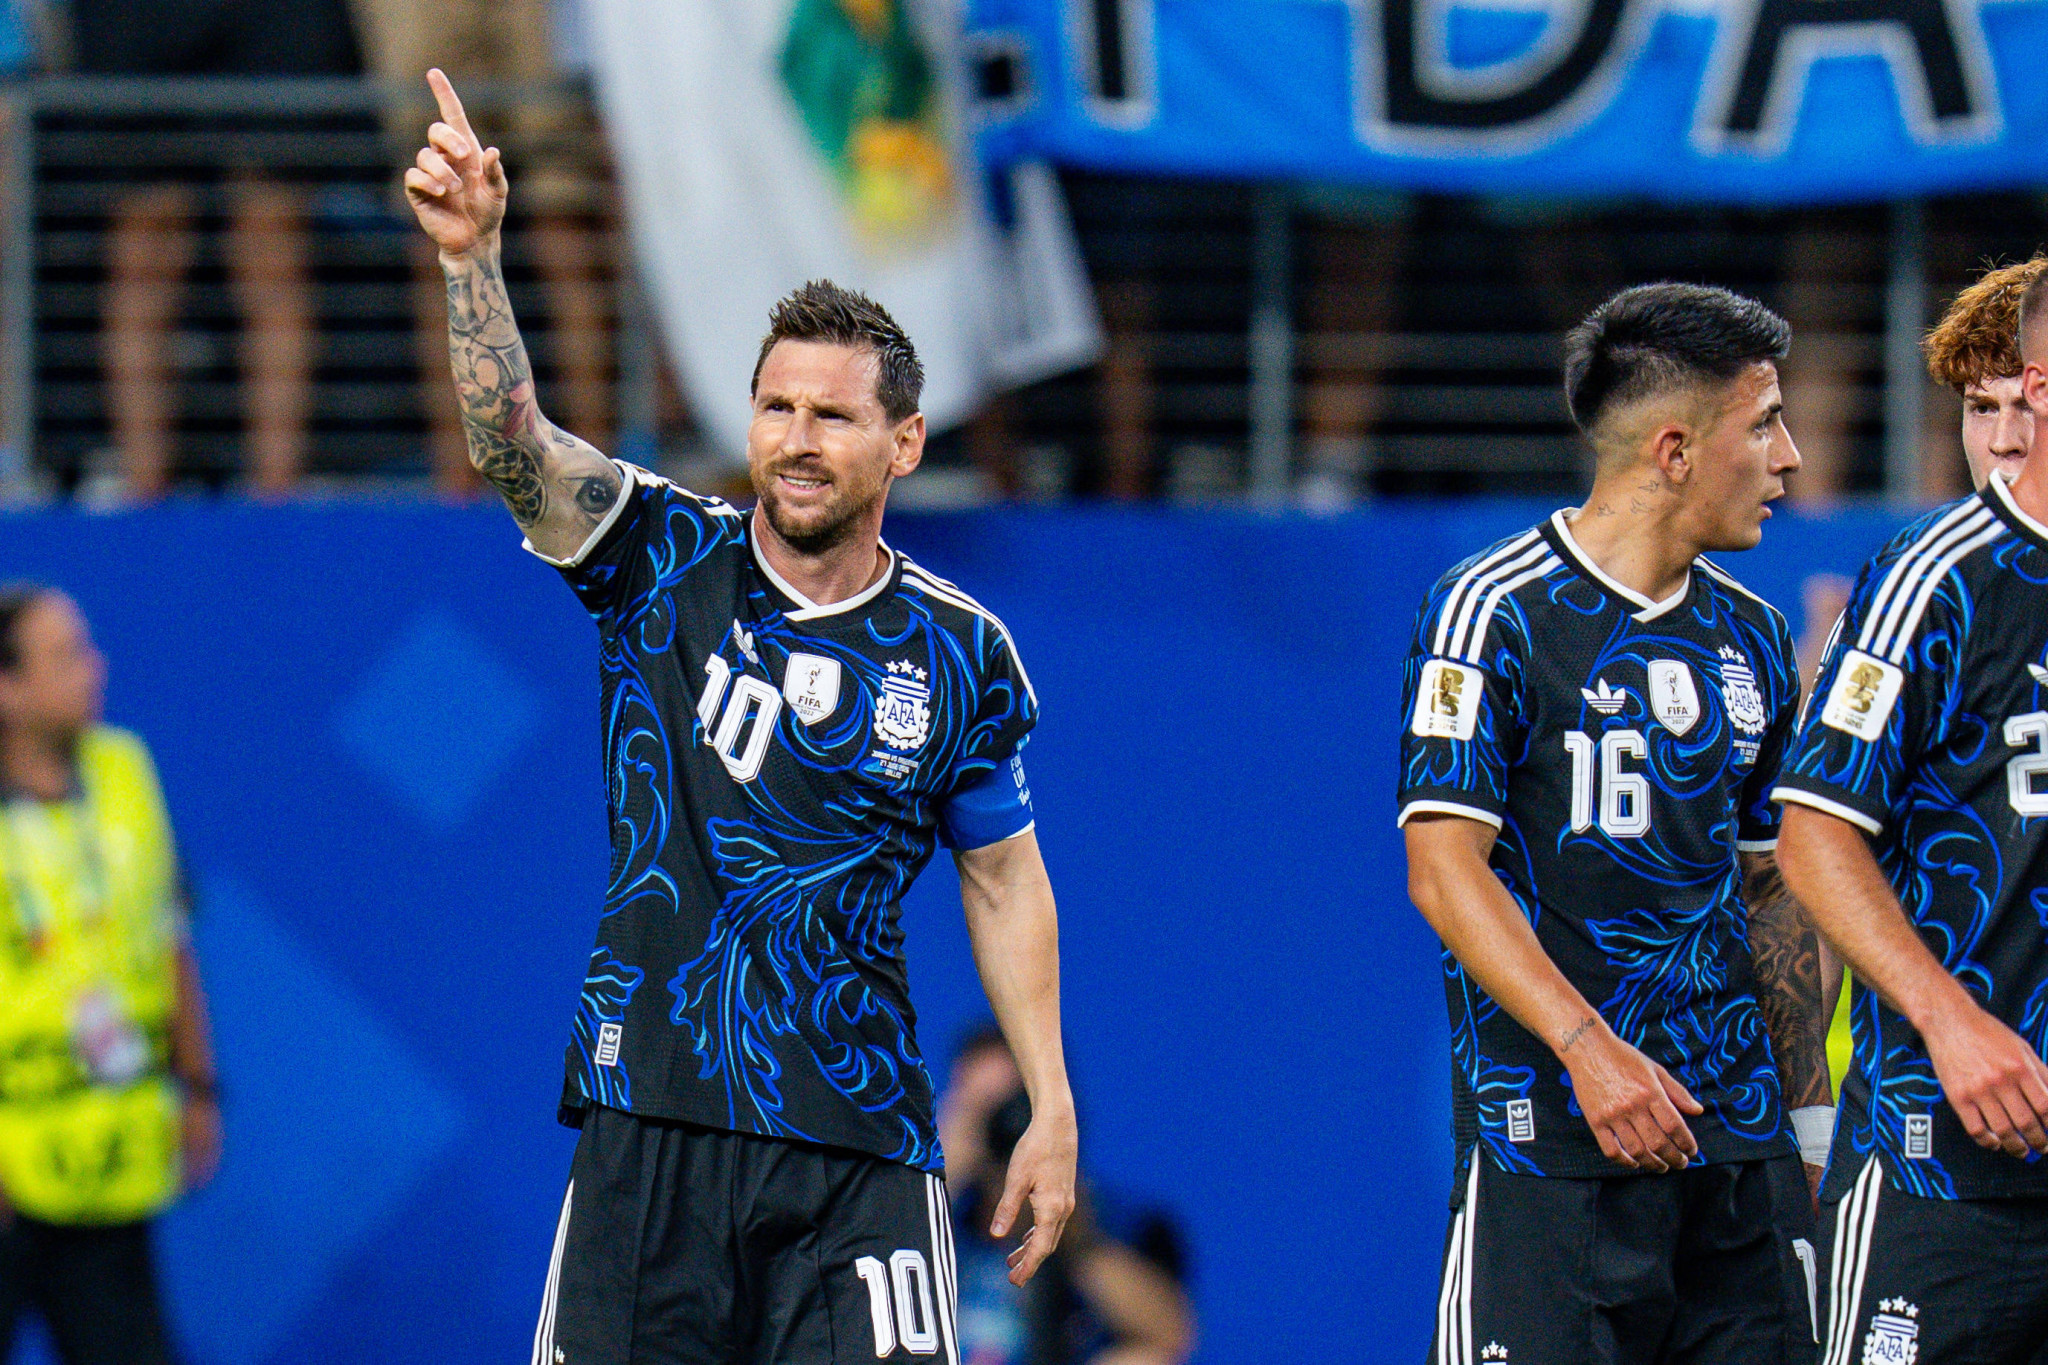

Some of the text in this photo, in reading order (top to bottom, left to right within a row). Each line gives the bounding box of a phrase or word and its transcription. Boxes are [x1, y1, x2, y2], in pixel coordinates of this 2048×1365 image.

[798, 696, 821, 708] FIFA
[799, 708, 814, 717] 2022
[887, 696, 917, 729] AFA
[1667, 706, 1688, 715] FIFA
[1733, 683, 1756, 714] AFA
[696, 652, 783, 783] 10
[1564, 729, 1651, 838] 16
[855, 1249, 939, 1358] 10
[1875, 1332, 1903, 1362] AFA
